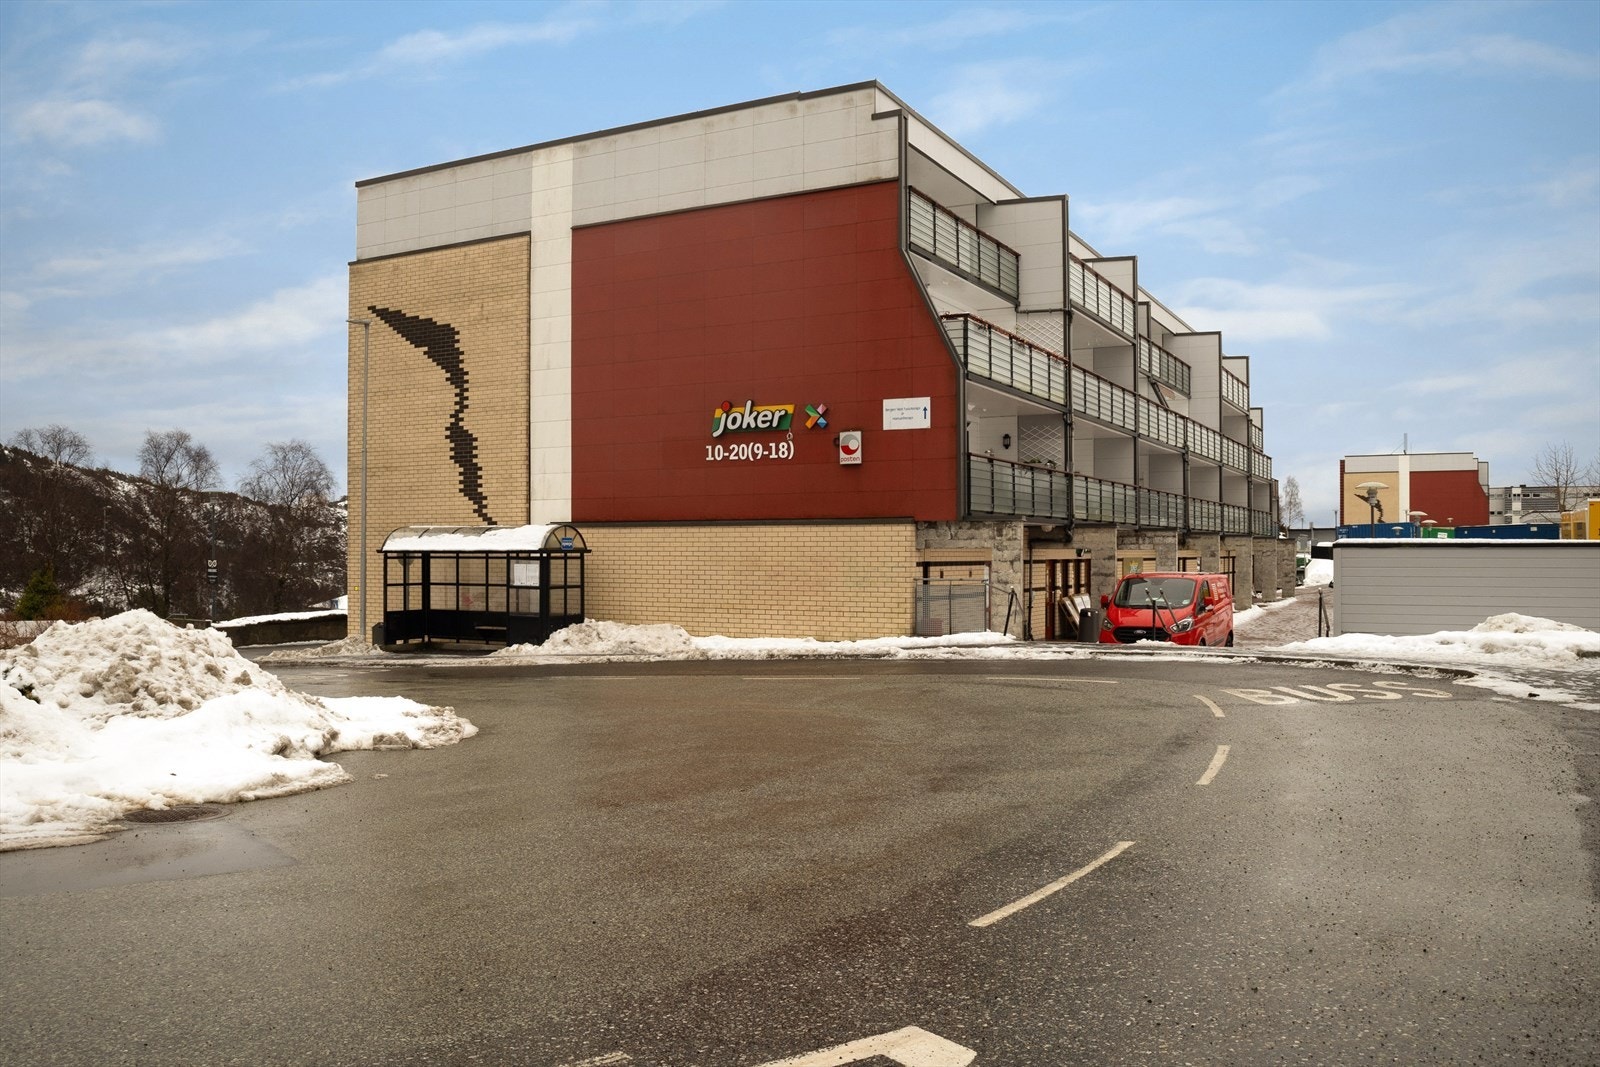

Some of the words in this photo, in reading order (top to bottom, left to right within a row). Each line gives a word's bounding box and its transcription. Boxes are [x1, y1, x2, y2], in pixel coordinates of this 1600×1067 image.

[712, 399, 786, 438] joker
[705, 441, 794, 461] 10-20(9-18)
[1220, 681, 1453, 705] BUSS
